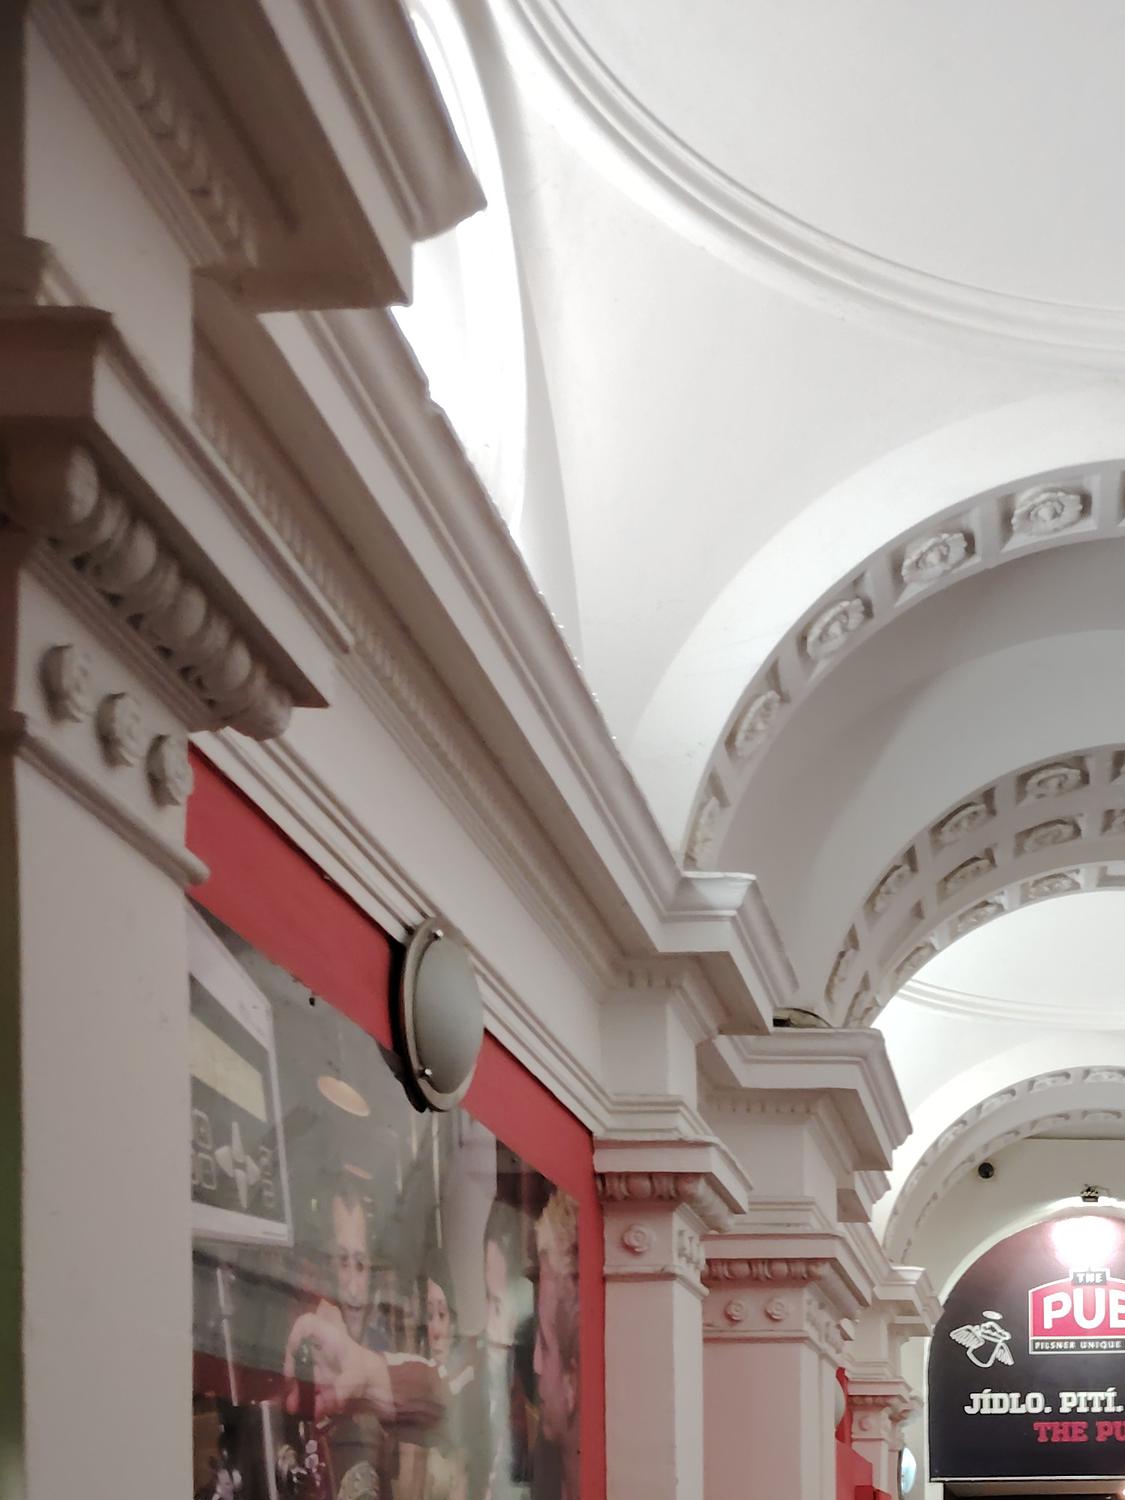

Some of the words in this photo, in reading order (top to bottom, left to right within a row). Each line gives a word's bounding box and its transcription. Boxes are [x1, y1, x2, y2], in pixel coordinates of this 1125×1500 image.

[1034, 1341, 1075, 1350] PILSNER
[1080, 1340, 1121, 1349] UNIQUE
[964, 1388, 1053, 1415] JÍDLO.
[1058, 1387, 1124, 1413] PITÍ.
[1033, 1421, 1088, 1442] THE
